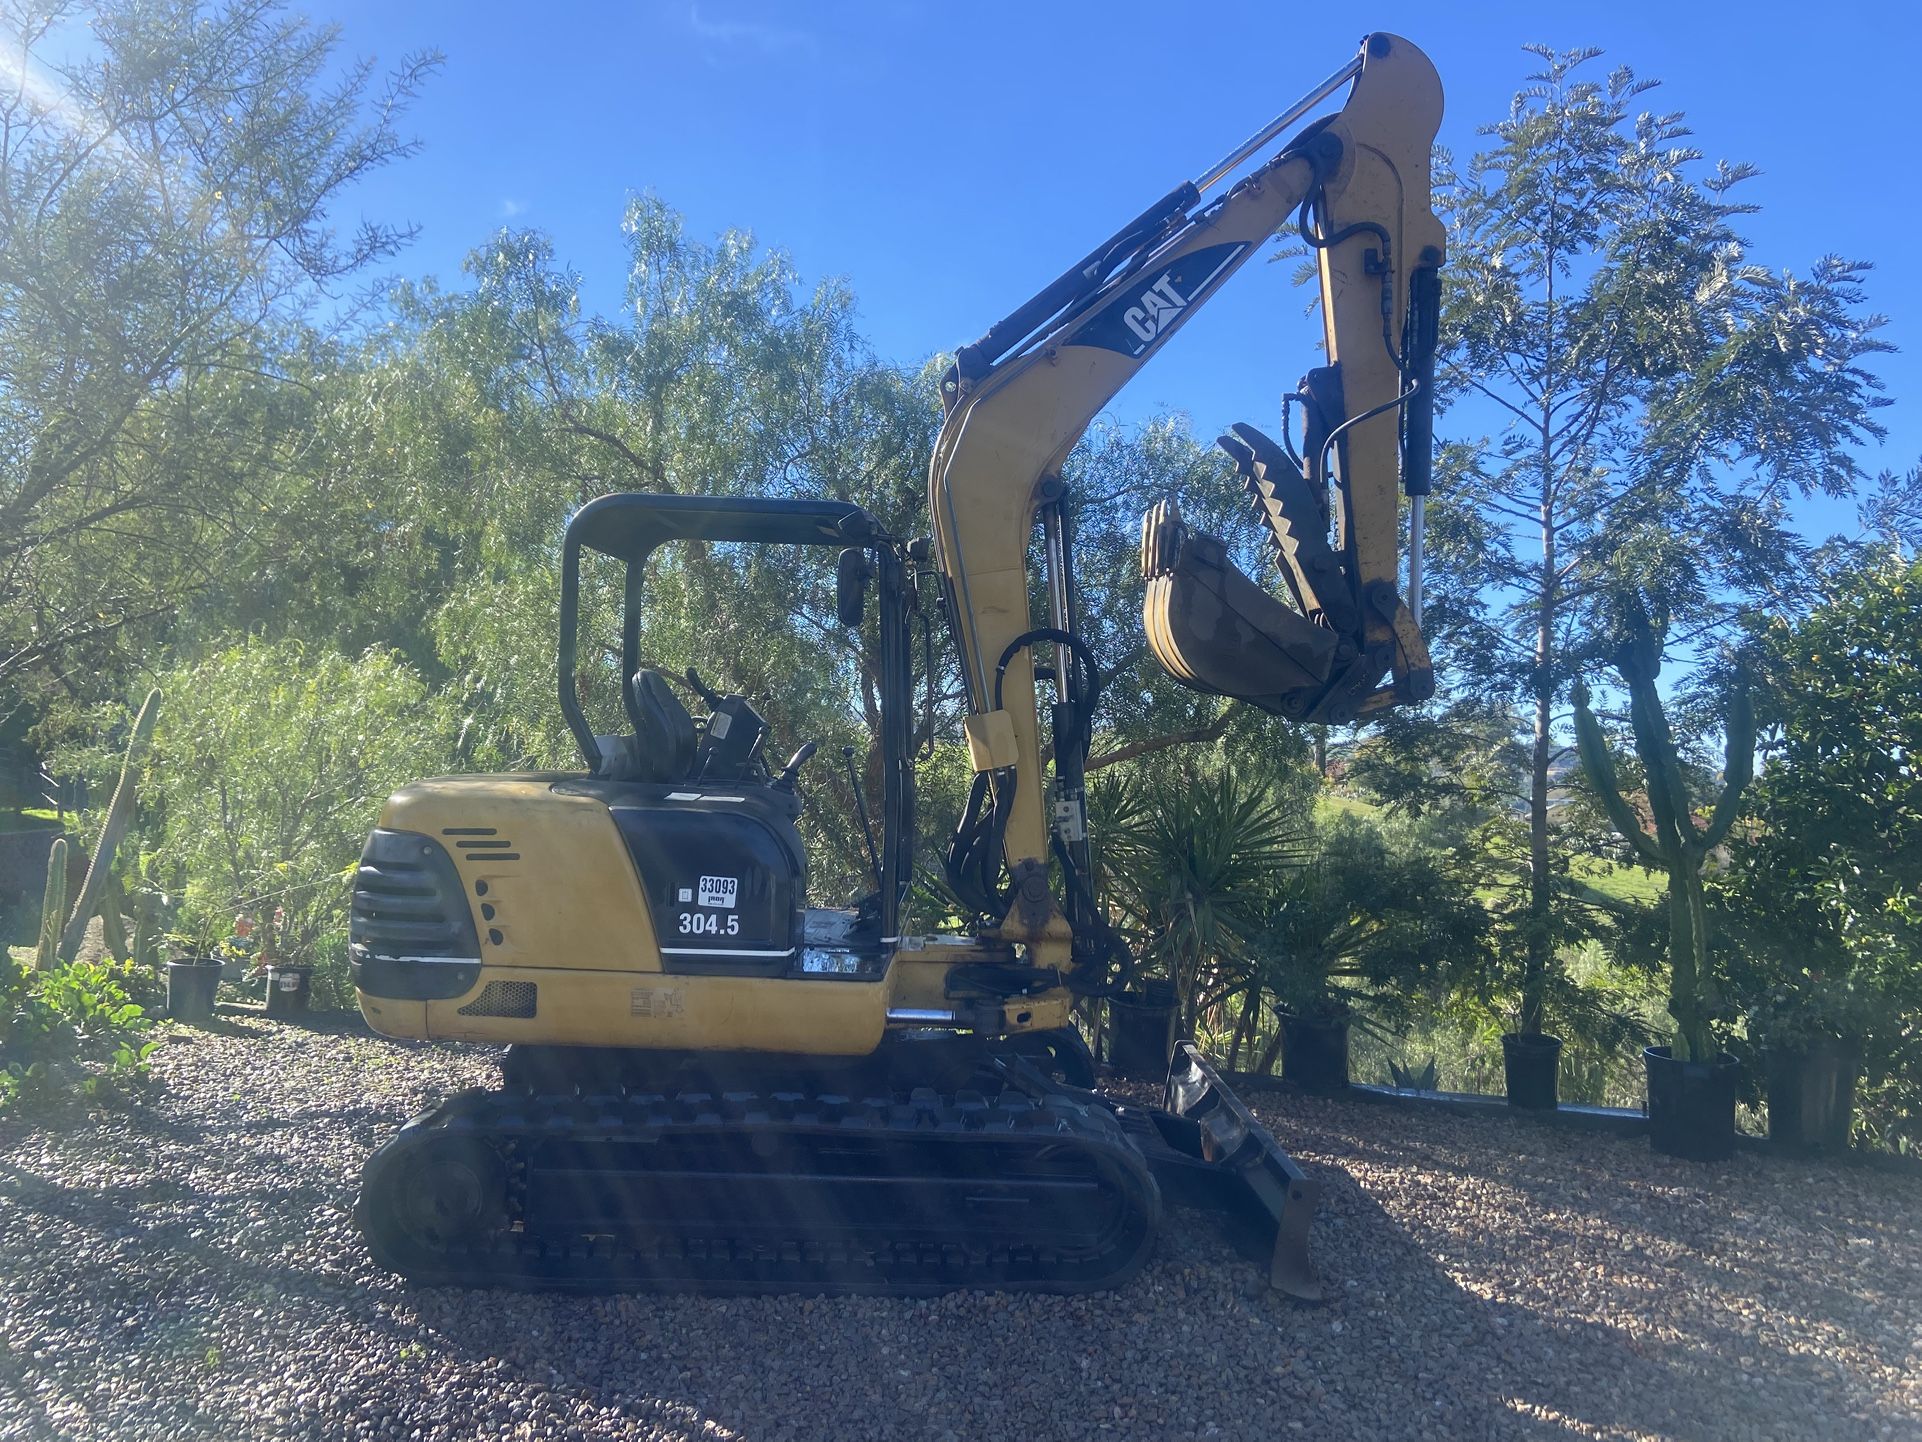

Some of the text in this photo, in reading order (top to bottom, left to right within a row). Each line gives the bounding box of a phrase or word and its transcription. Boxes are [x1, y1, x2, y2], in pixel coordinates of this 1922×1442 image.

[1124, 271, 1187, 342] CAT
[700, 877, 736, 895] 33093
[678, 912, 740, 935] 304.5
